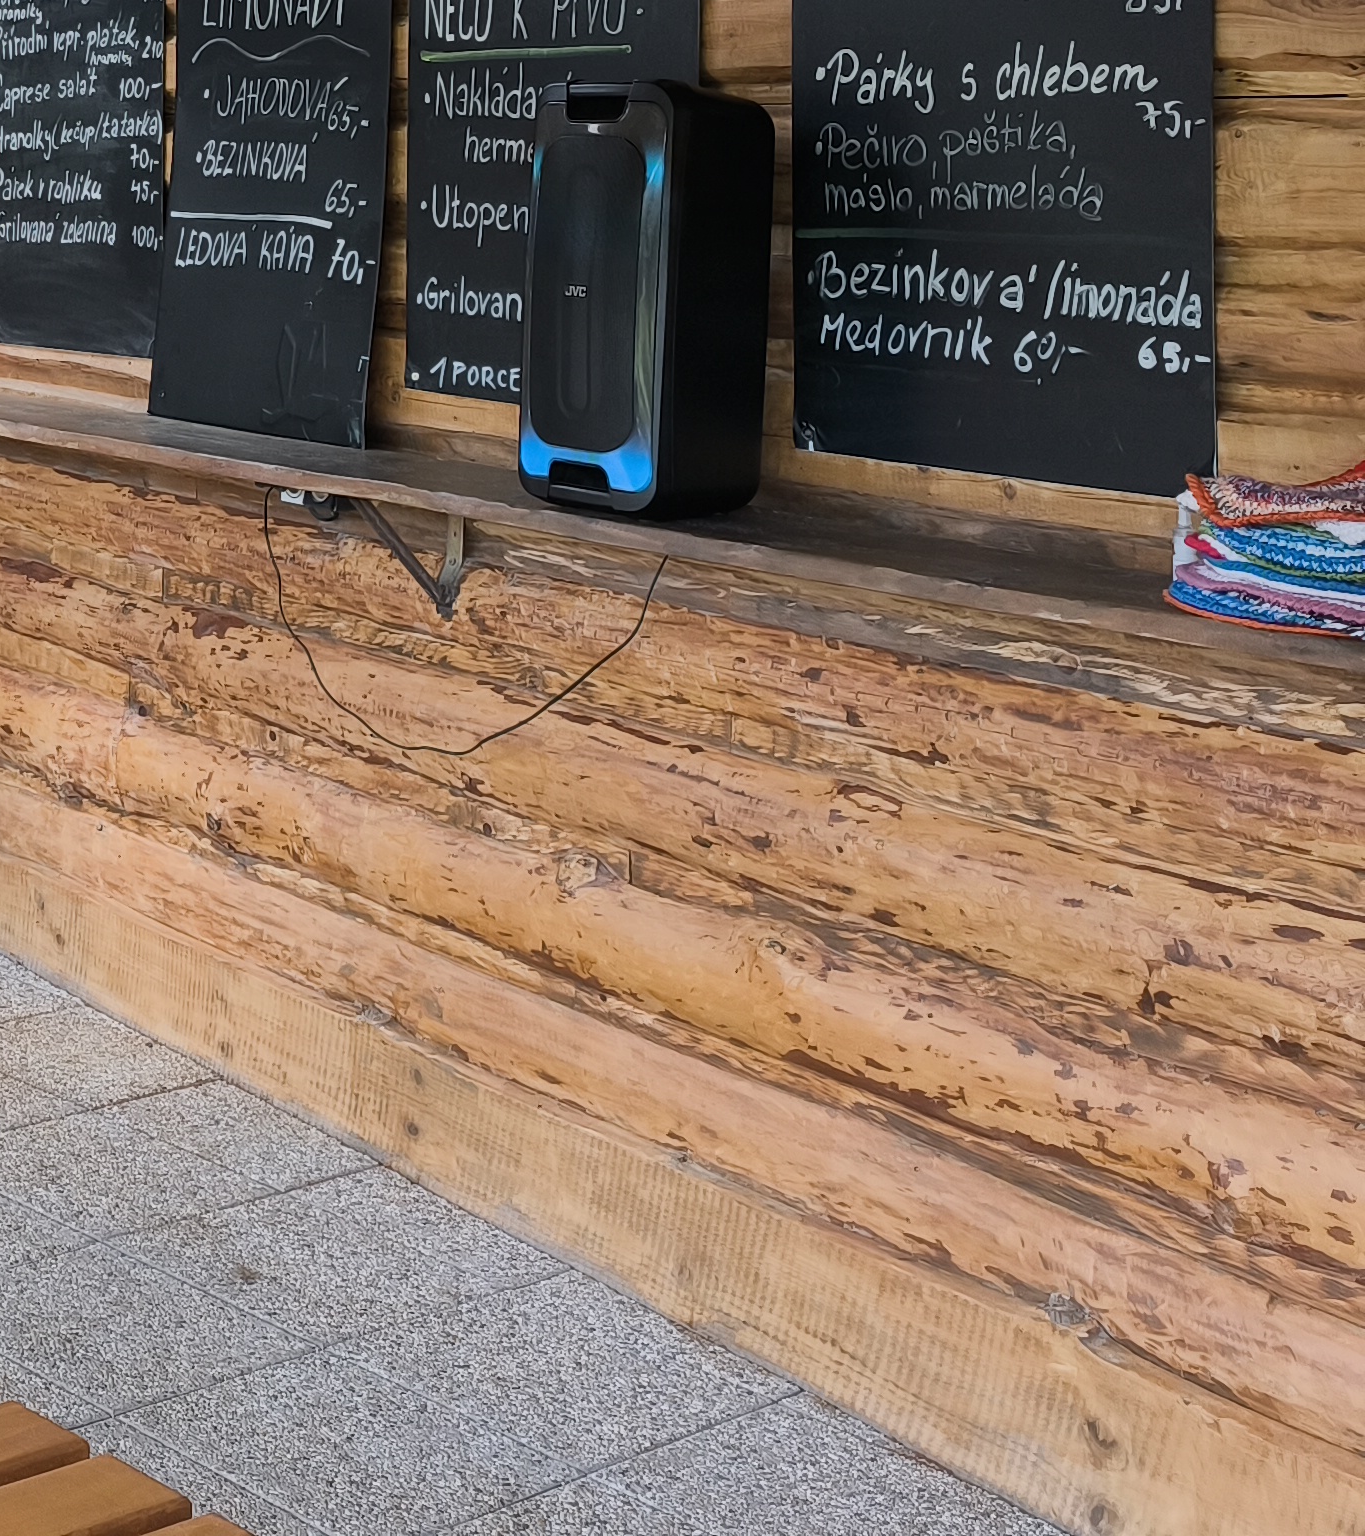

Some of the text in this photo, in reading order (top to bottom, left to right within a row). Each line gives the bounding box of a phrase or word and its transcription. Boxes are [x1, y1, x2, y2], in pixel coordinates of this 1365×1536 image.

[58, 67, 97, 98] salát
[217, 75, 348, 124] JAHODOVÁ
[826, 41, 1159, 113] Párky s chlebem
[203, 132, 318, 183] BEZINKOVÁ
[432, 184, 529, 247] Utopen
[931, 164, 1104, 221] marmeláda
[61, 215, 116, 246] zelenina
[175, 224, 257, 267] LEDOVÁ
[259, 226, 314, 274] KÁVA
[424, 275, 523, 322] Grilovan
[565, 285, 587, 298] JVC
[430, 356, 520, 391] 1 PORCE
